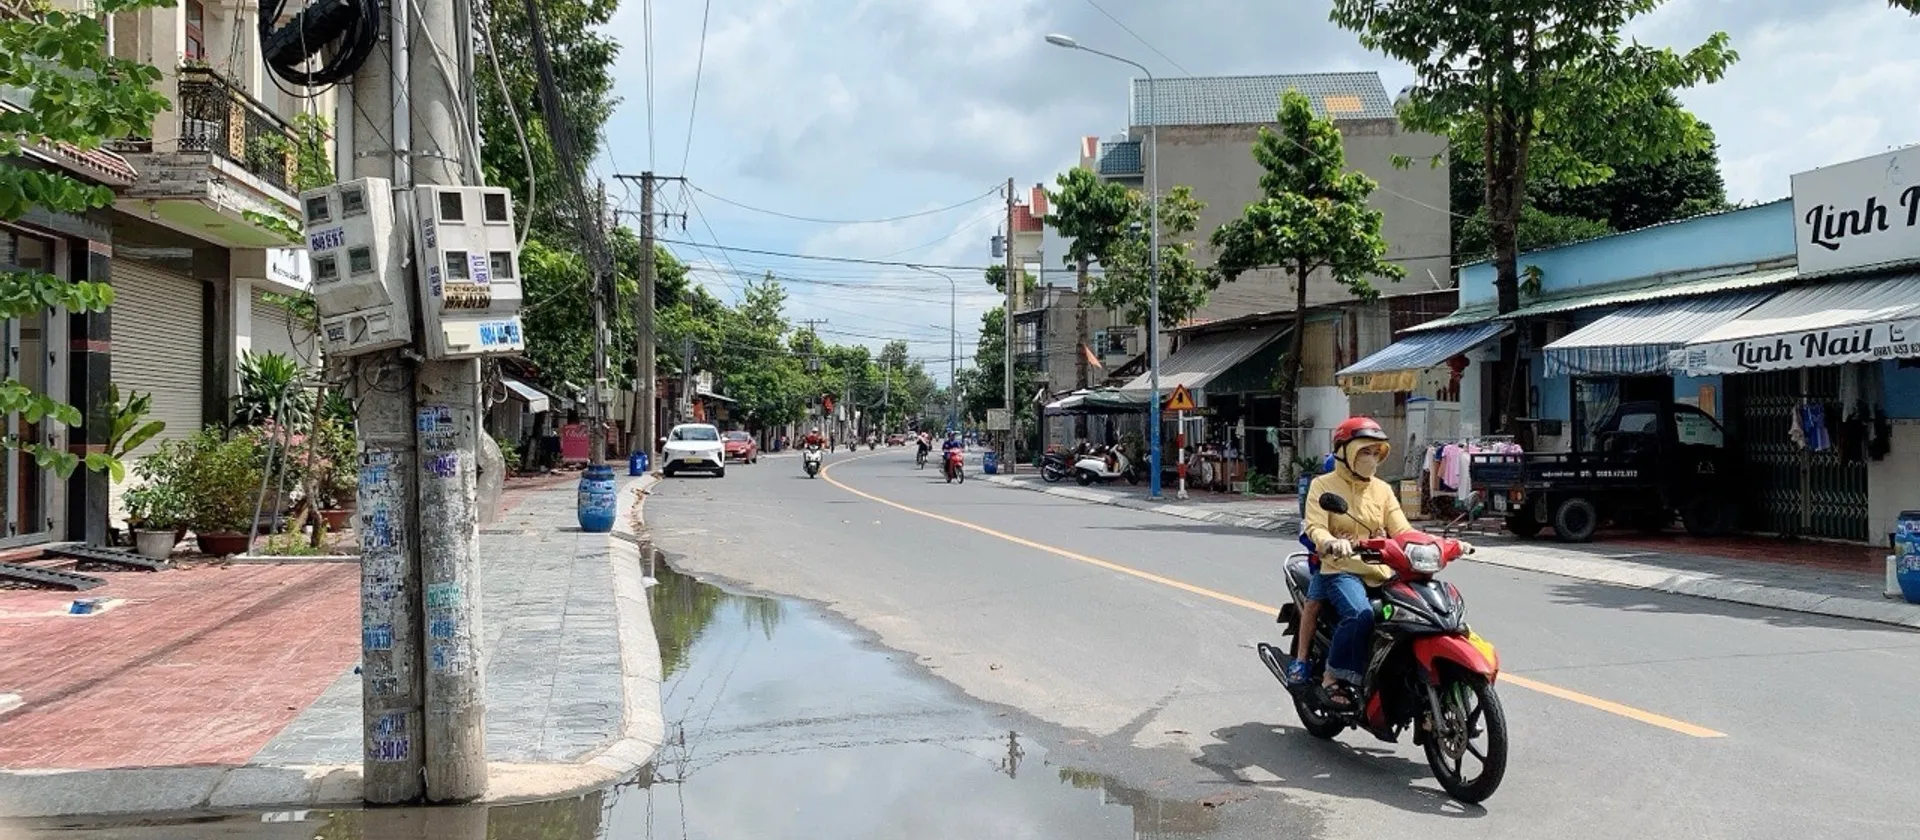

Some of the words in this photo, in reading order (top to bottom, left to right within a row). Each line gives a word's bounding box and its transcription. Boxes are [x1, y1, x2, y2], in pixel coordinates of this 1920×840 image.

[1805, 197, 1890, 251] Linh
[1732, 339, 1793, 370] Linh
[1799, 328, 1873, 358] Nail
